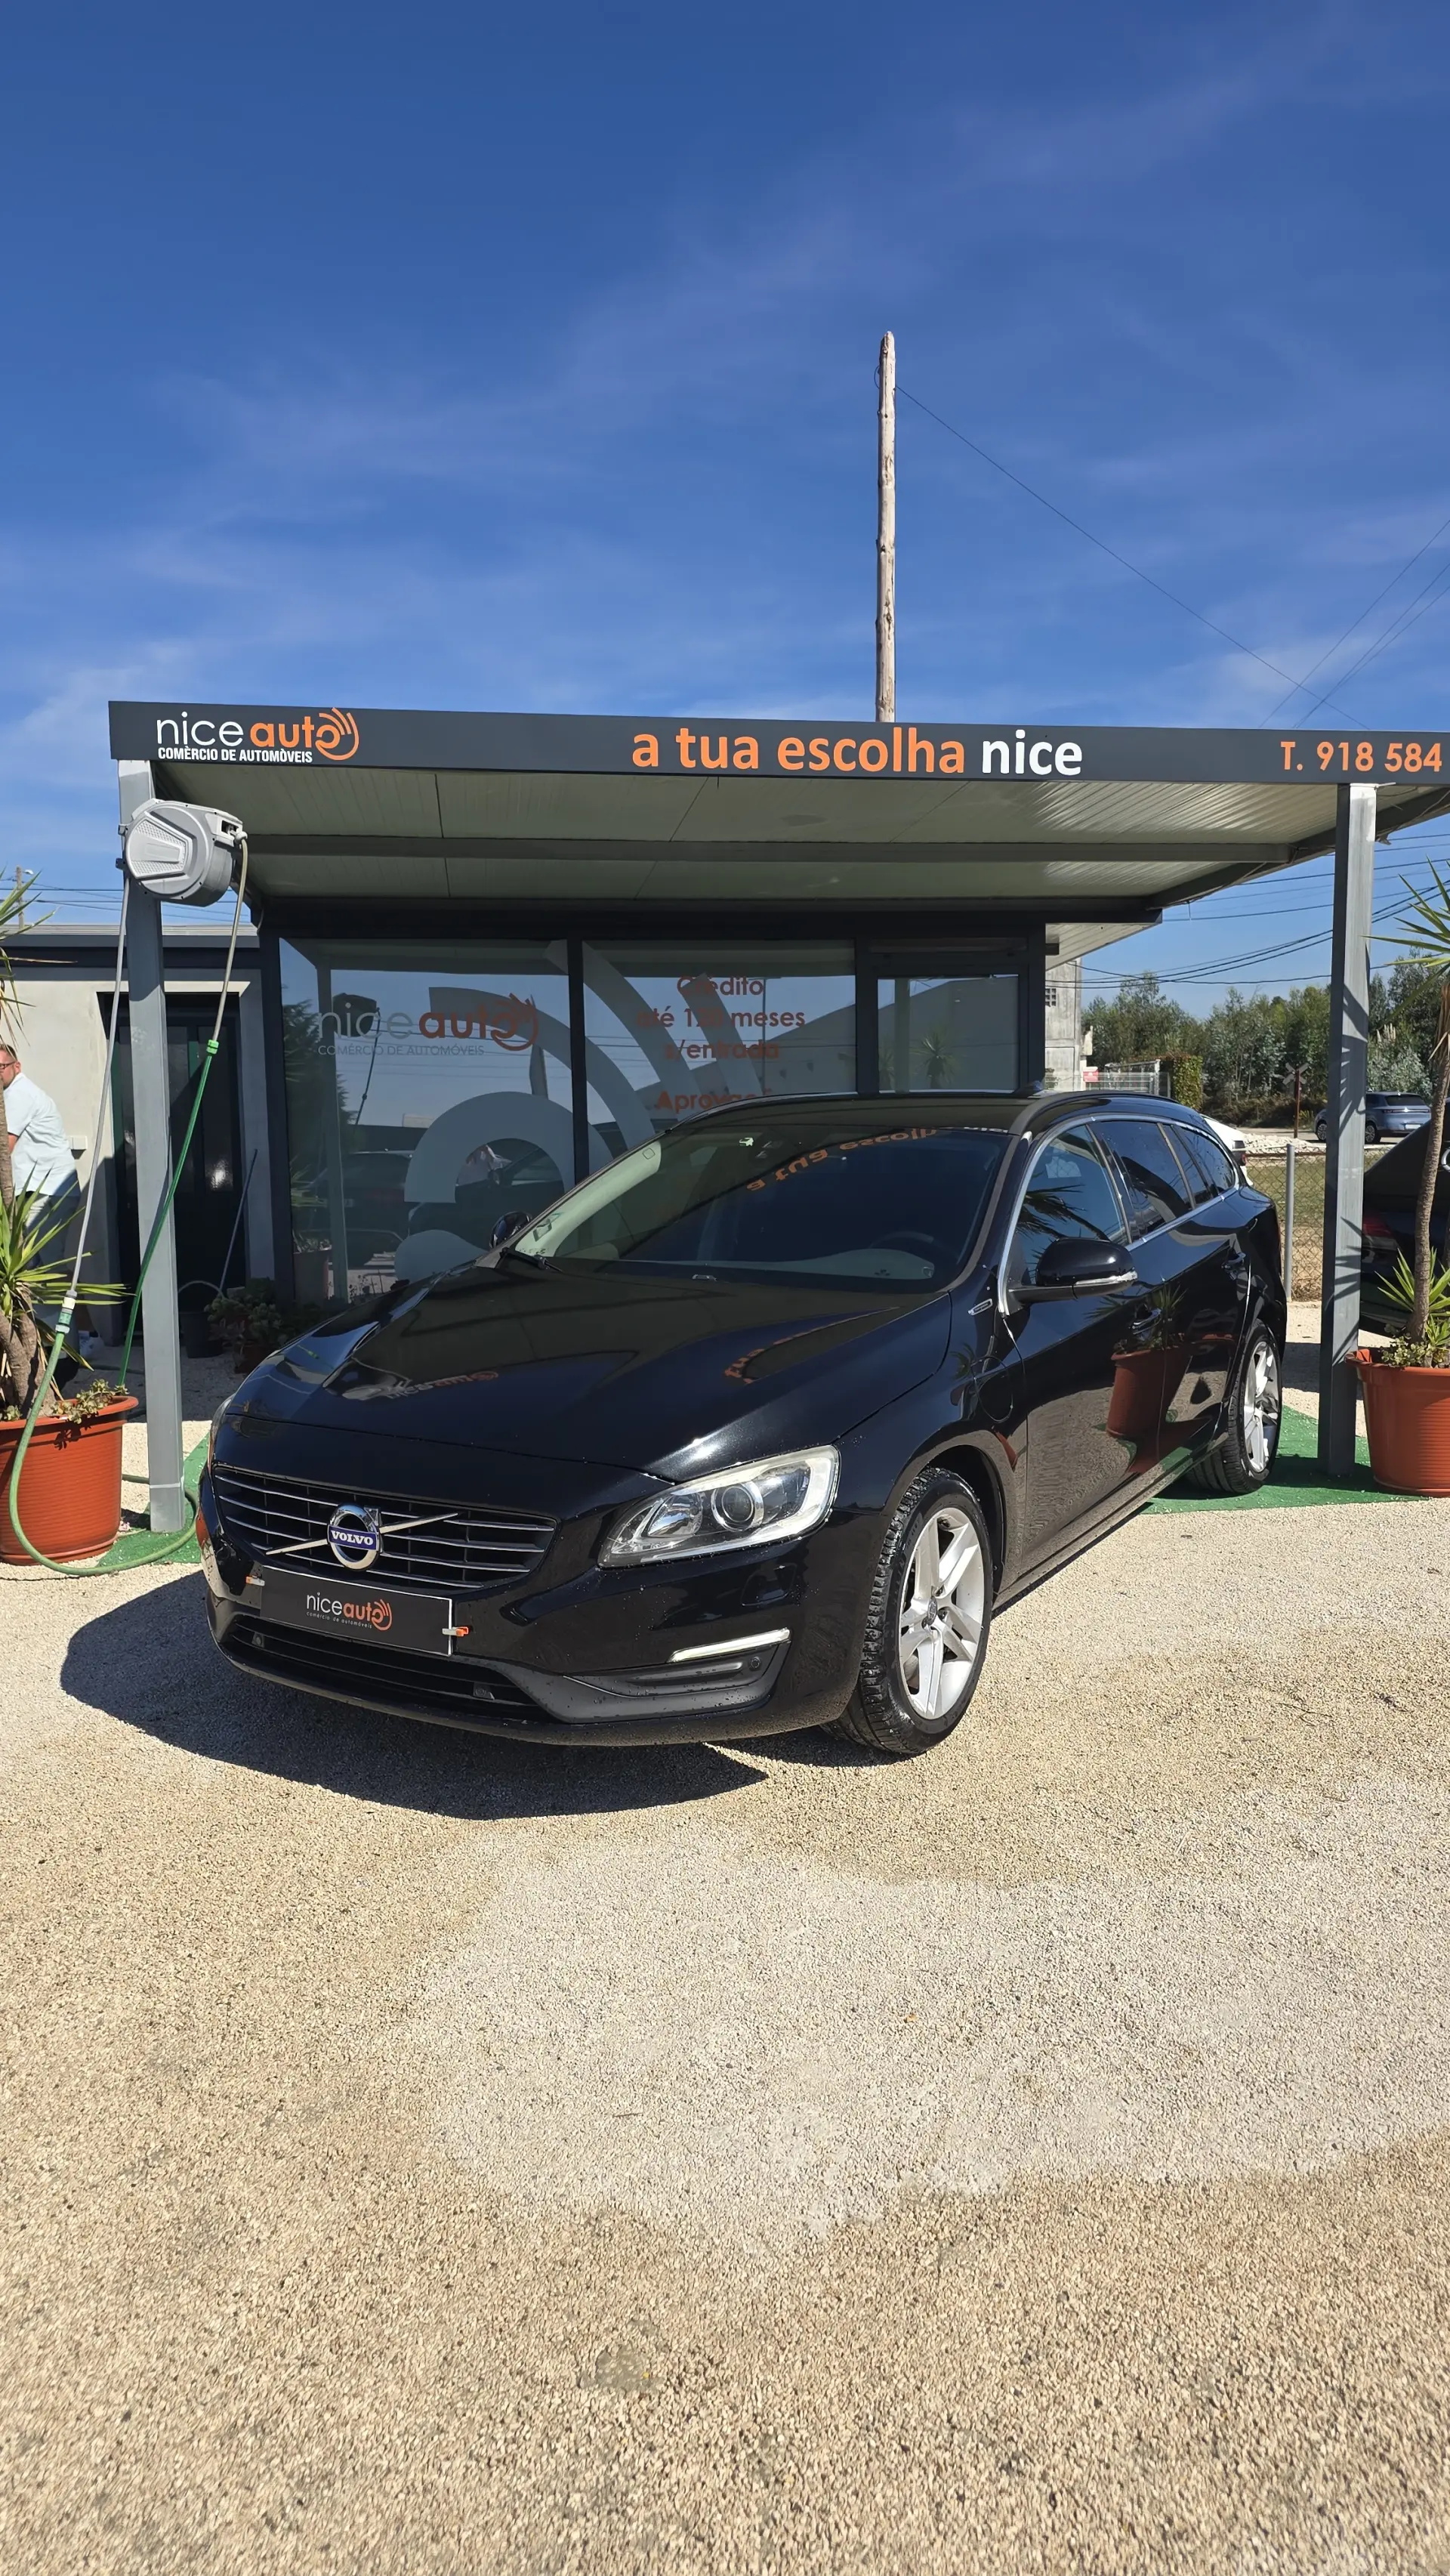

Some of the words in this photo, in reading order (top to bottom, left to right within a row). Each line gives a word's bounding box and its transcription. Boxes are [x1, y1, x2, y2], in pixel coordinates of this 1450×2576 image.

[221, 749, 236, 761] DE
[632, 733, 659, 768] a
[675, 727, 759, 770] tua
[777, 727, 965, 774] escolha
[982, 730, 1082, 776] nice
[1280, 741, 1303, 771] T.
[1316, 741, 1374, 772] 918
[1384, 743, 1442, 773] 584
[677, 975, 764, 996] Crédito
[637, 1005, 674, 1028] até
[683, 1008, 723, 1028] 120
[730, 1011, 806, 1028] meses
[318, 1042, 383, 1056] COMÉRCIO
[387, 1045, 403, 1056] DE
[407, 1042, 485, 1056] AUTOMÓVEIS
[331, 1530, 373, 1546] VOLVO
